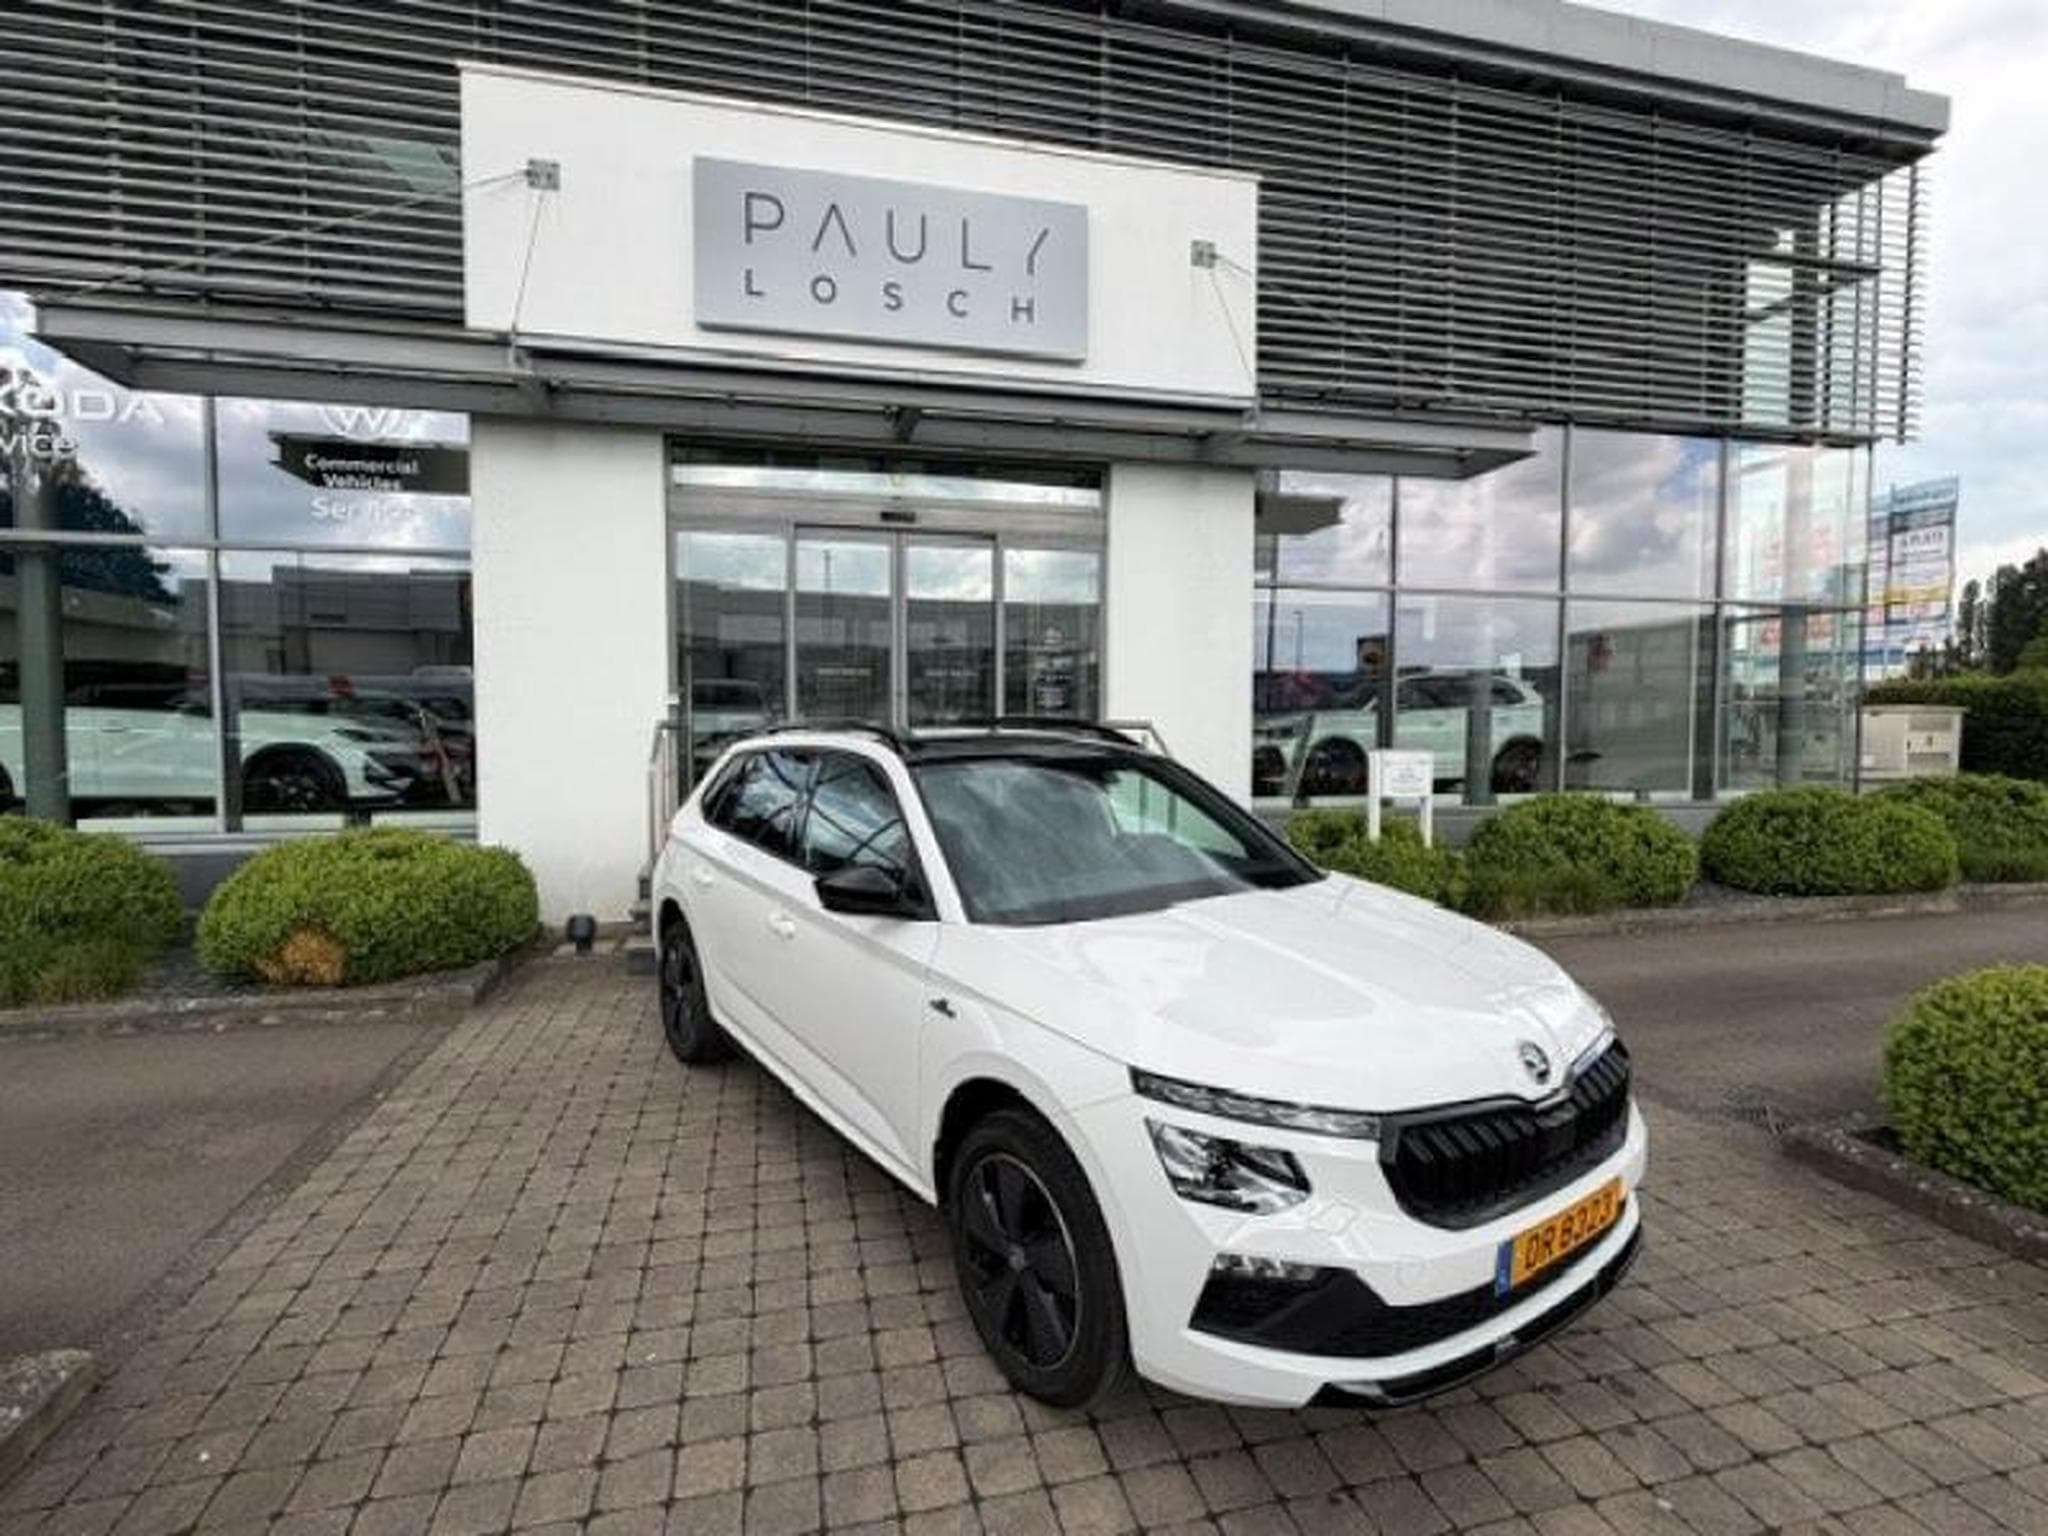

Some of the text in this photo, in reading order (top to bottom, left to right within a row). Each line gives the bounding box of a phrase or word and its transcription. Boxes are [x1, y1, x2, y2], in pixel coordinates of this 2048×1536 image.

[744, 191, 1051, 275] PAULY
[744, 268, 1035, 324] LOSCH
[304, 453, 420, 475] Commercial
[321, 472, 401, 493] Vehicles
